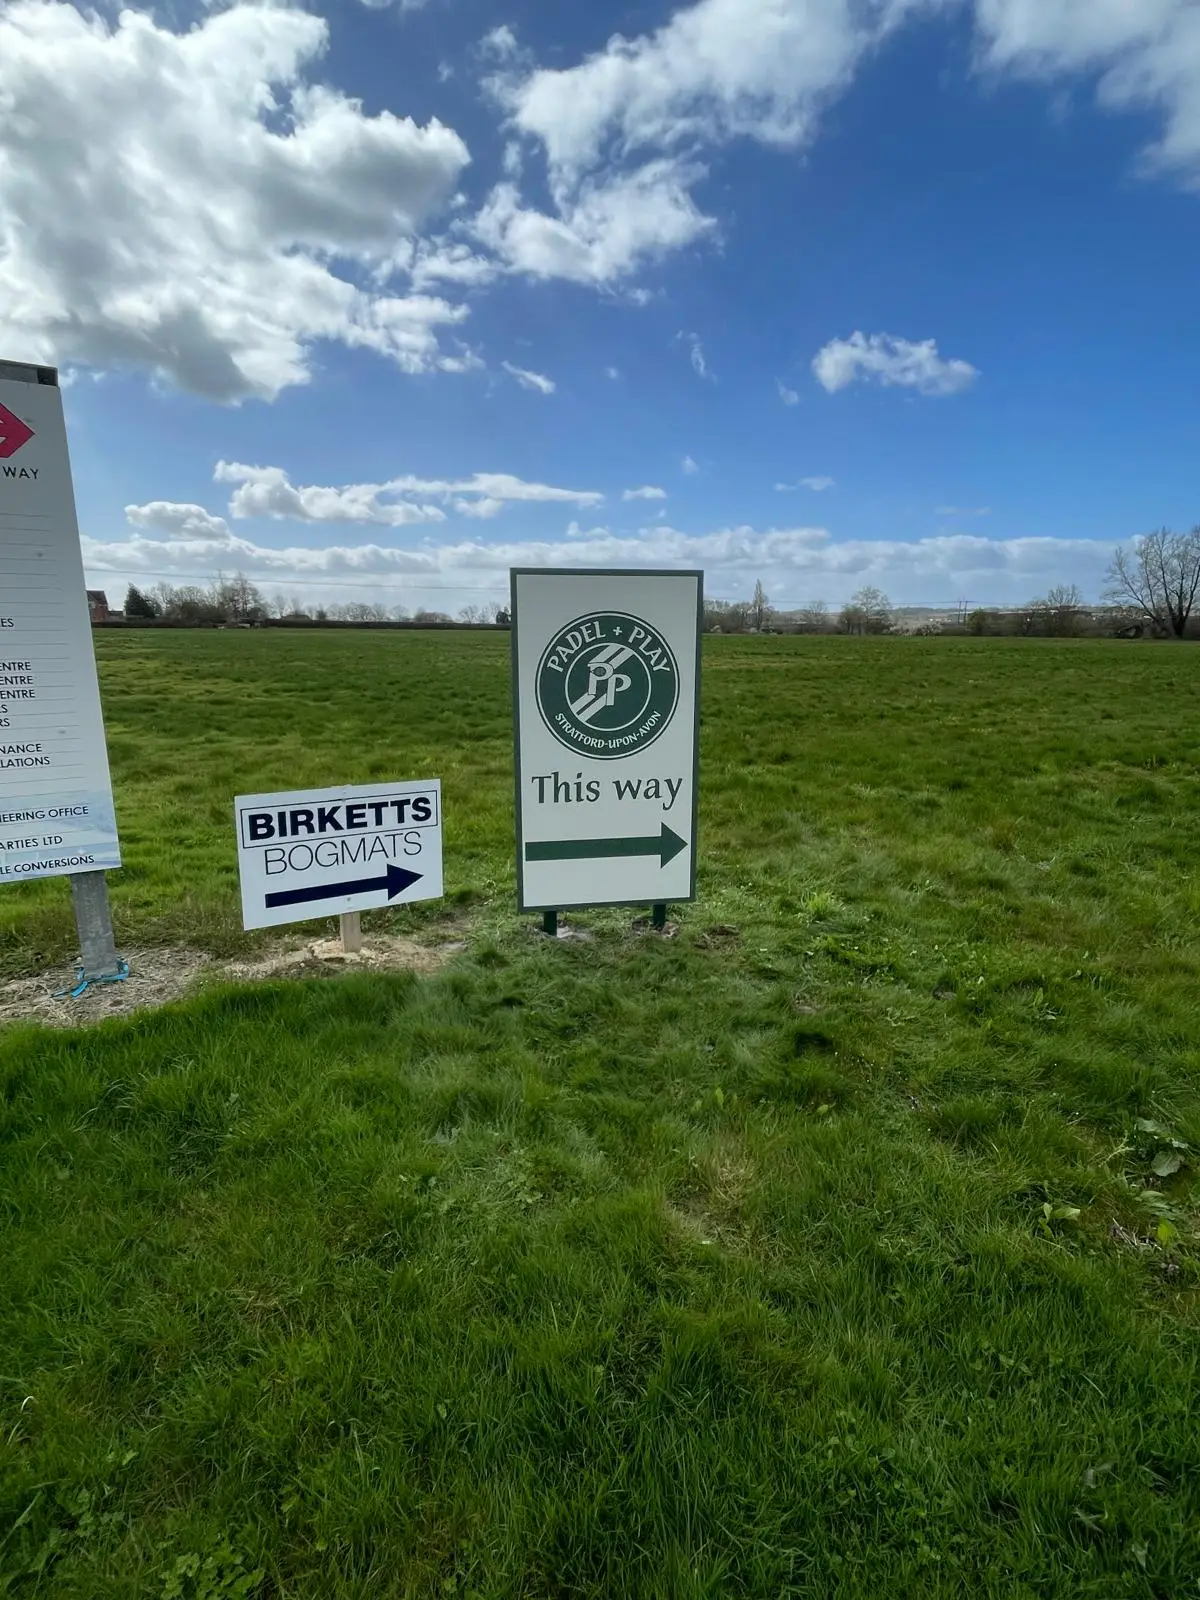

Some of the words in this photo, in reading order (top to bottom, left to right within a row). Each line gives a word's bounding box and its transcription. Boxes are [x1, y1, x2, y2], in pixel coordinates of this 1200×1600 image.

[2, 466, 39, 479] WAY
[0, 618, 14, 628] ES
[547, 620, 606, 673] PADEL
[628, 626, 671, 672] PLAY
[0, 689, 36, 699] ENTRE
[555, 710, 662, 749] STRATFORD-UPON-AVON
[0, 756, 50, 768] LATIONS
[531, 771, 601, 804] This
[612, 777, 683, 811] way
[0, 810, 45, 823] EERING
[48, 806, 89, 818] OFFICE
[248, 797, 432, 841] BIRKETTS
[43, 835, 63, 846] LTD
[264, 831, 422, 875] BOGMATS
[14, 855, 95, 873] CONVERSIONS
